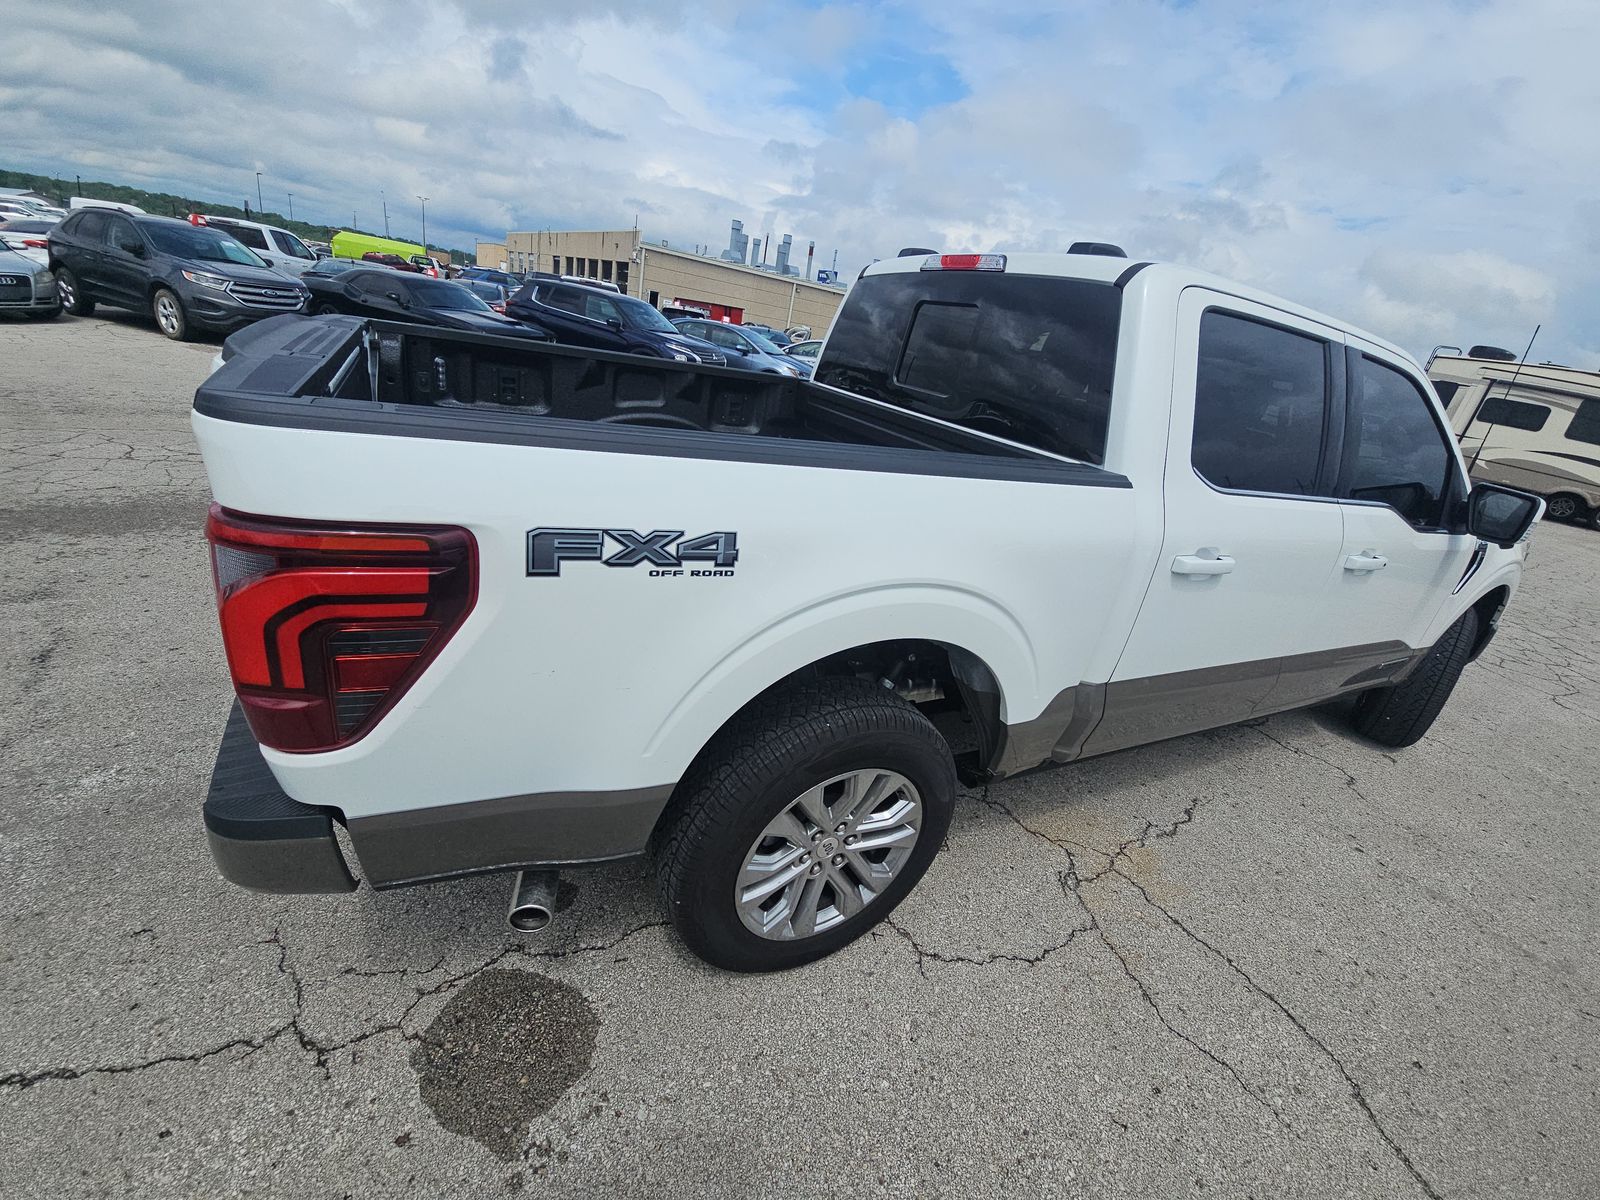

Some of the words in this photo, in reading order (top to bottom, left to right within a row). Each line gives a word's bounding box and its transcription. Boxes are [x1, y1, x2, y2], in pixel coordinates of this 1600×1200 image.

[526, 527, 739, 577] FX4
[649, 569, 684, 577] OFF
[690, 569, 735, 577] ROAD
